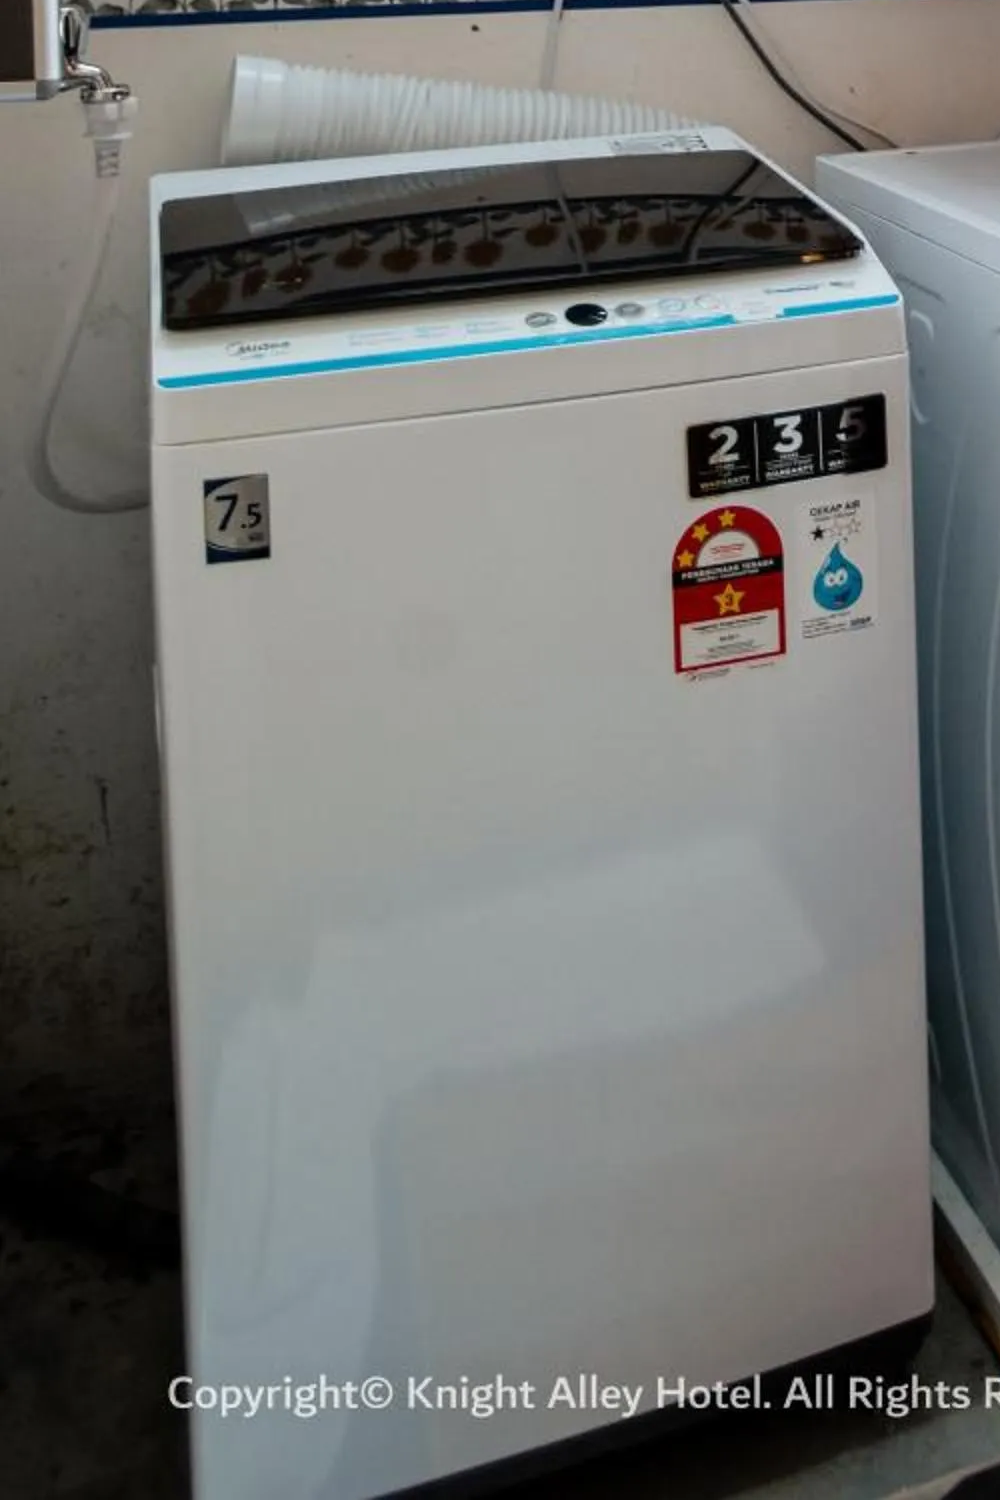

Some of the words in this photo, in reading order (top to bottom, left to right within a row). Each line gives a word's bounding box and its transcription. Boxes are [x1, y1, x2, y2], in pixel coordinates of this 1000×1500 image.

[773, 415, 803, 453] 3
[835, 406, 866, 441] 5
[708, 425, 740, 465] 2
[214, 493, 263, 531] 7.5
